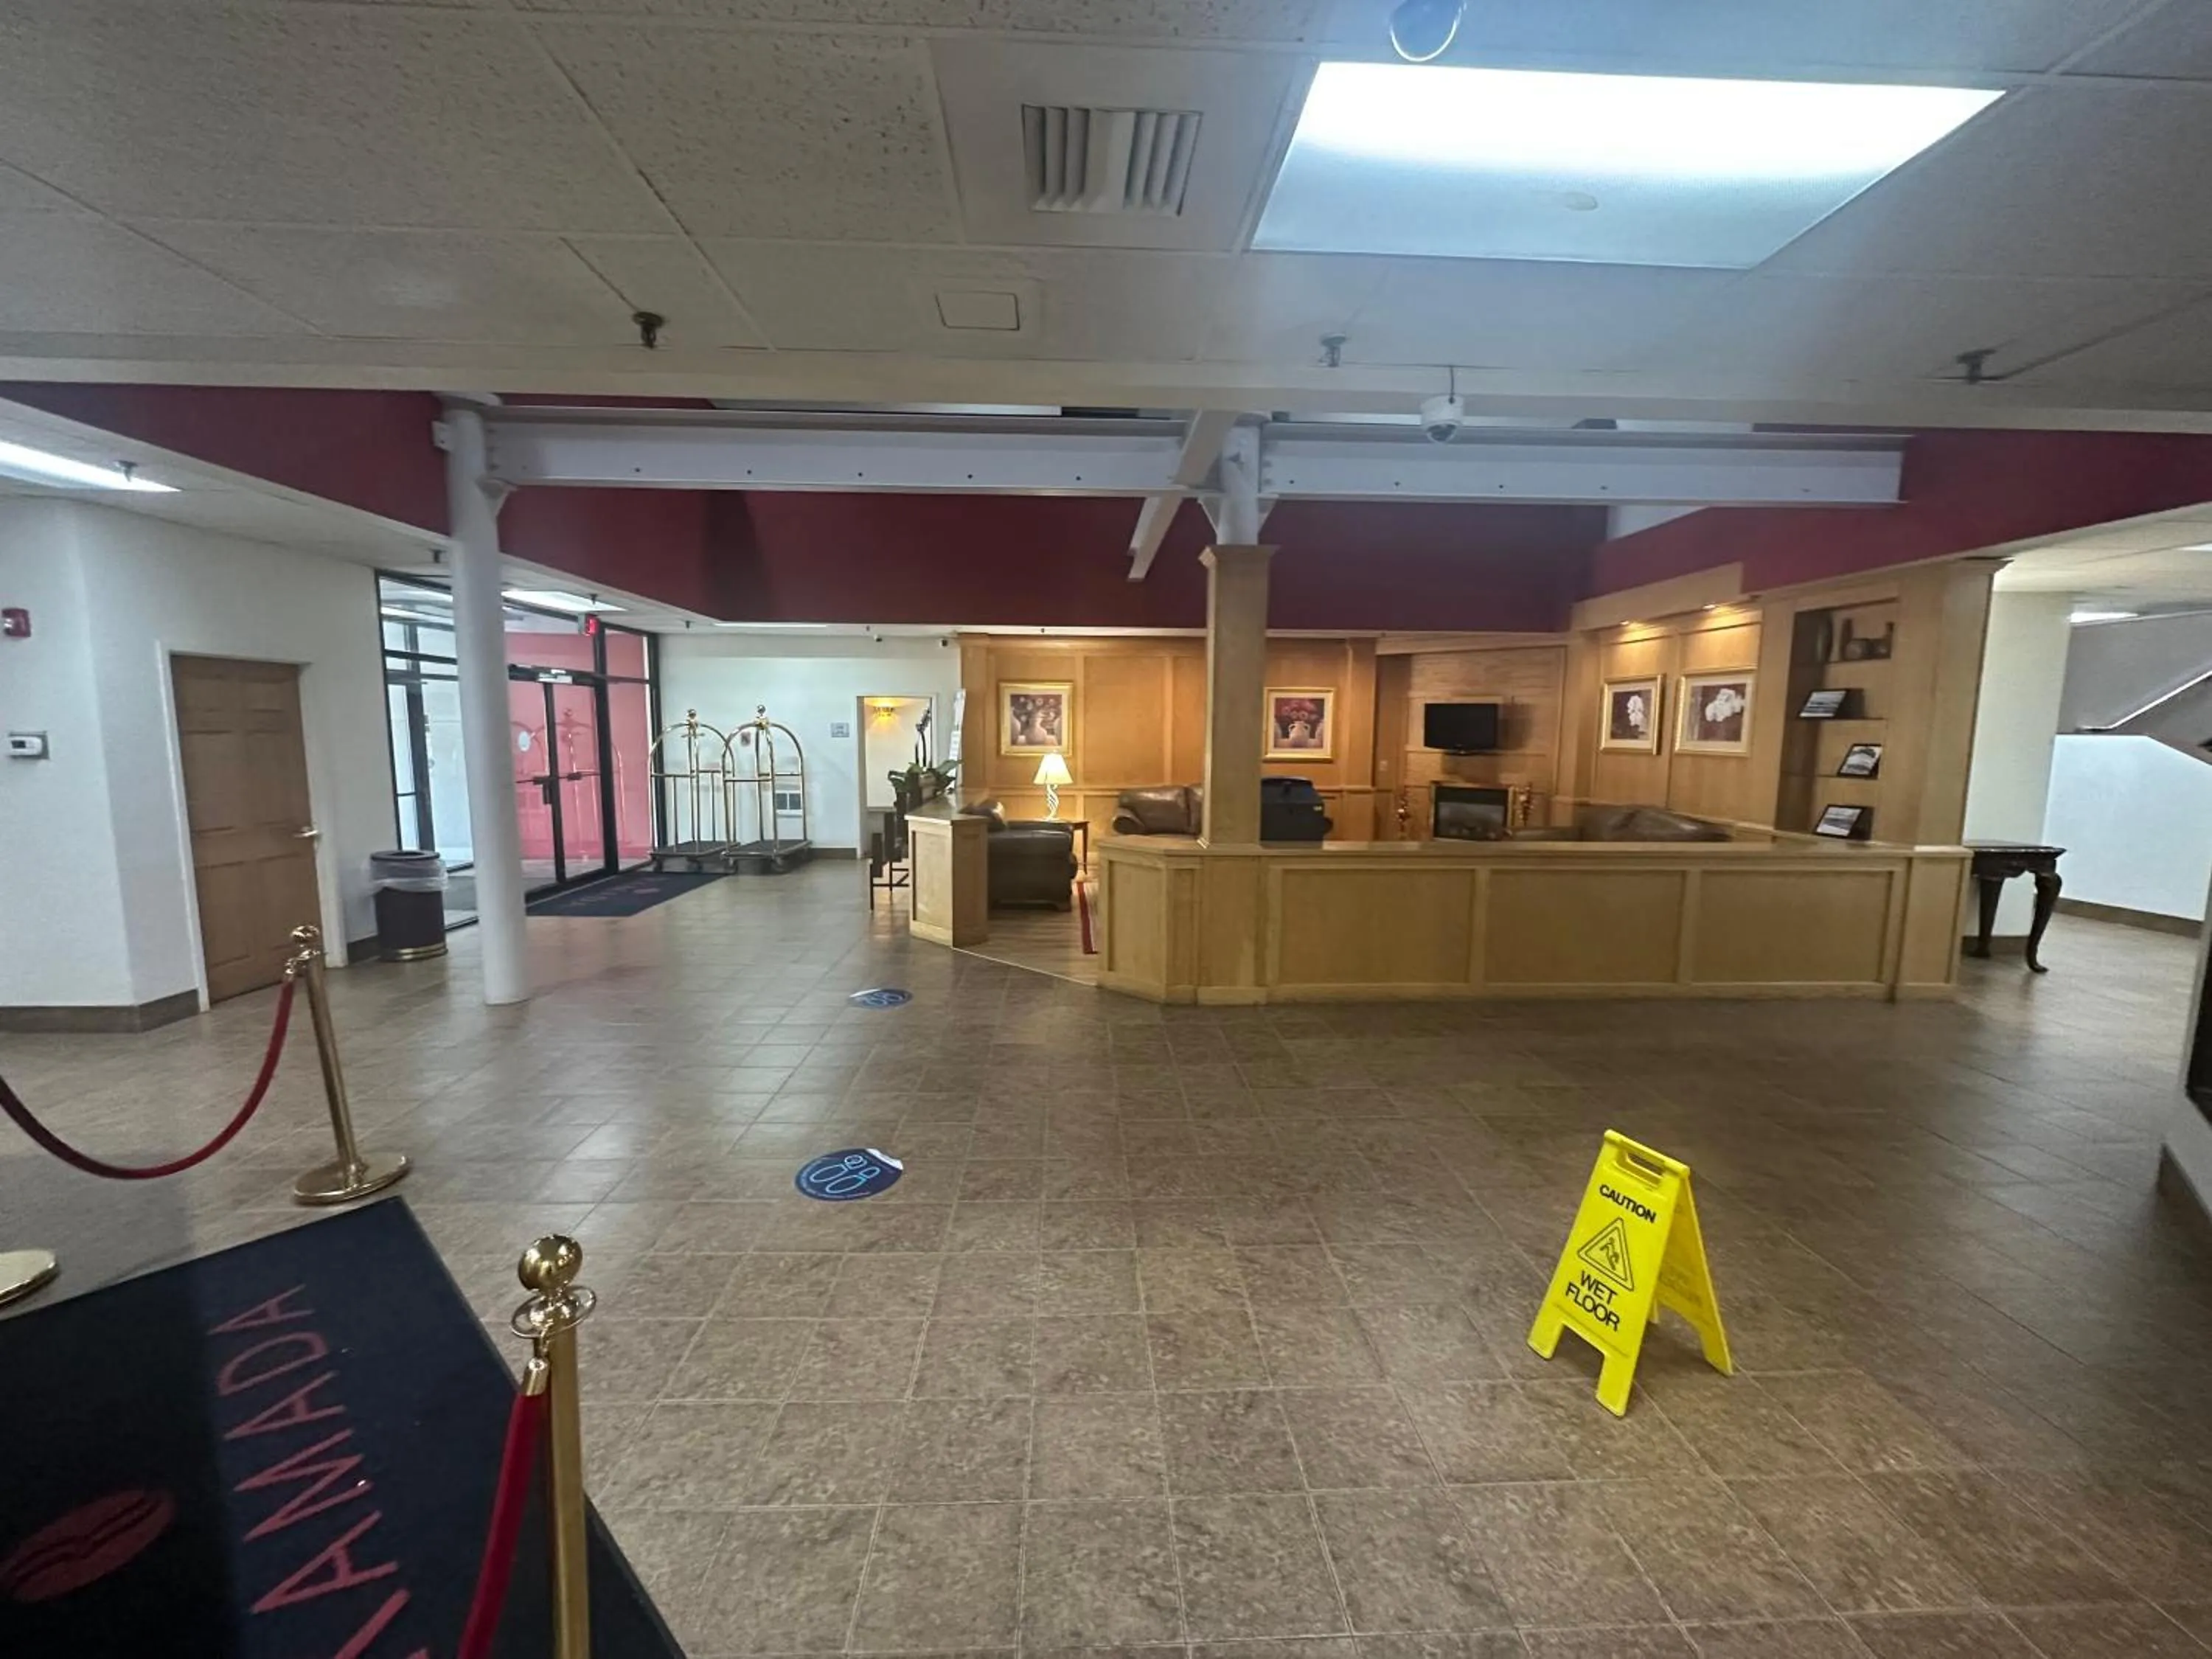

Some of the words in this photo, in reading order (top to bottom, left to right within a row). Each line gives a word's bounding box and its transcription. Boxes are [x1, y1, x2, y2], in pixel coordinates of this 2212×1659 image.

[1599, 1185, 1656, 1223] CAUTION
[1581, 1271, 1618, 1304] WET
[1565, 1282, 1620, 1332] FLOOR
